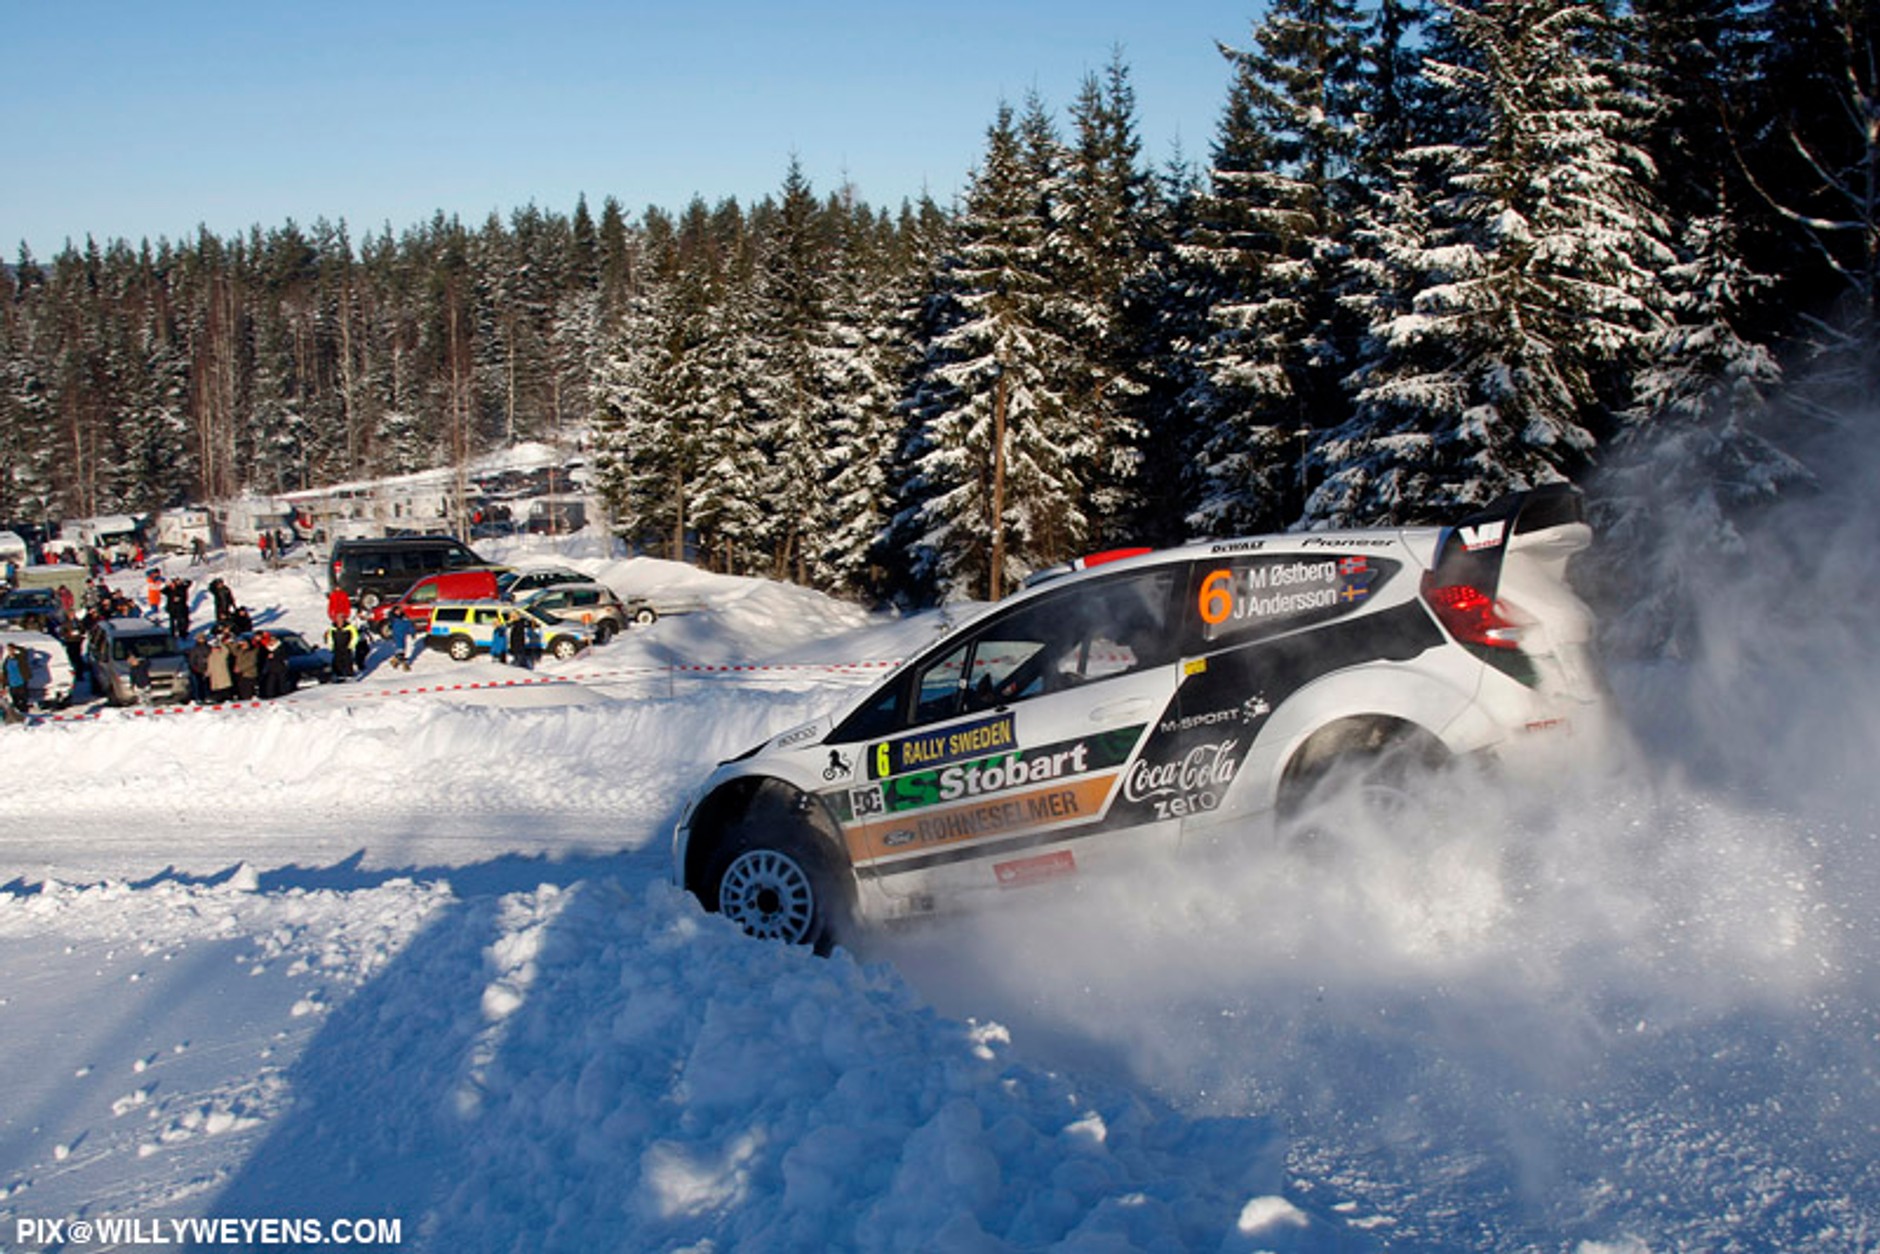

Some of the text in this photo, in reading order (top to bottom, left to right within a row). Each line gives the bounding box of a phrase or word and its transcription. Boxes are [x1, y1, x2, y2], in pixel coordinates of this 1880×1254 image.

[1302, 537, 1395, 549] Pioneer
[1198, 569, 1234, 624] 6
[1249, 560, 1336, 590] M Østberg
[1233, 587, 1337, 619] J Andersson
[876, 721, 1012, 776] 6 RALLY SWEDEN
[939, 742, 1088, 800] Stobart
[1124, 739, 1238, 802] Coca-Cola
[1153, 791, 1217, 819] zero
